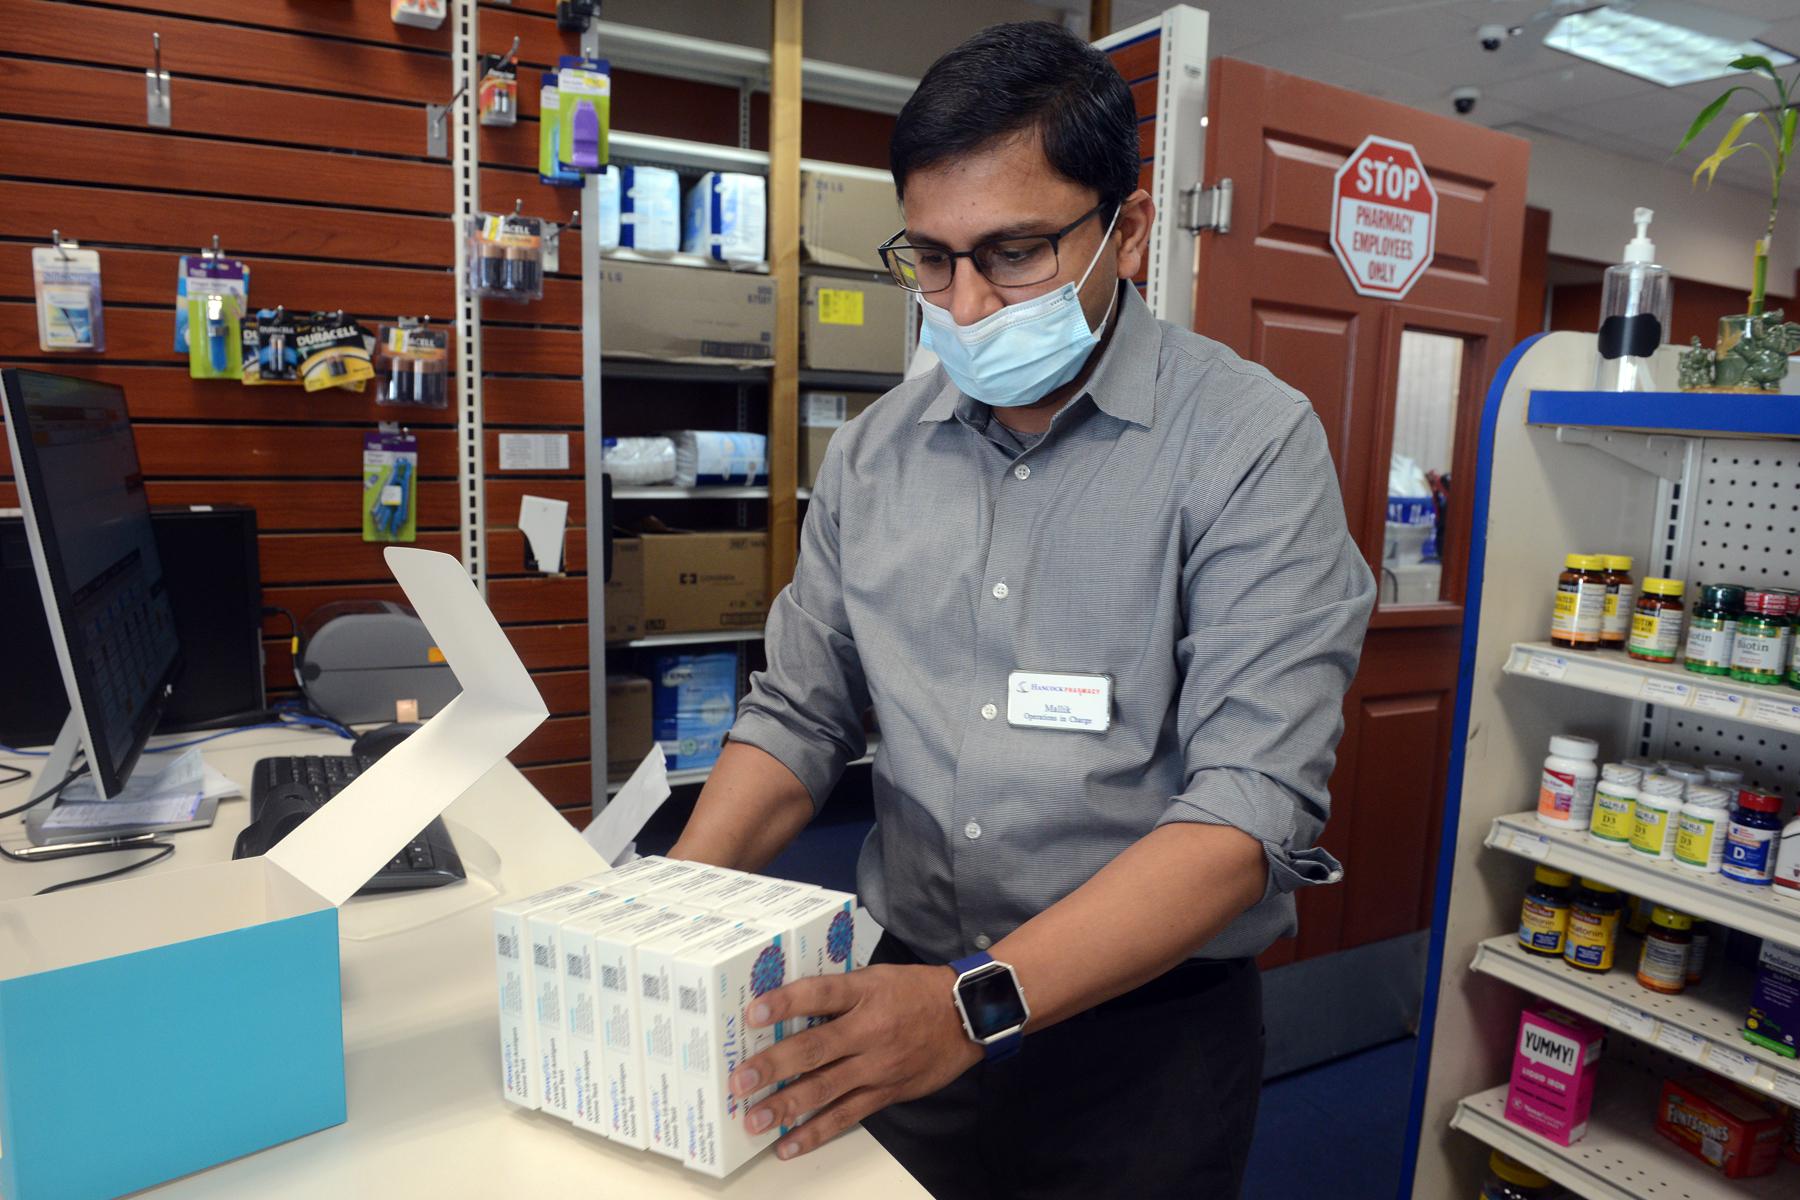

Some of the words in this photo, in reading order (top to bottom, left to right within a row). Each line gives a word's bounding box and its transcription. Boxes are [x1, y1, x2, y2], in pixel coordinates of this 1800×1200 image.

[1355, 157, 1420, 201] STOP
[1356, 205, 1415, 235] PHARMACY
[1352, 231, 1414, 260] EMPLOYEES
[1367, 260, 1398, 283] ONLY
[296, 325, 359, 347] DURACELL
[1024, 713, 1058, 721] Operations
[1069, 716, 1092, 725] Charge
[1525, 1030, 1575, 1066] YUMMY!
